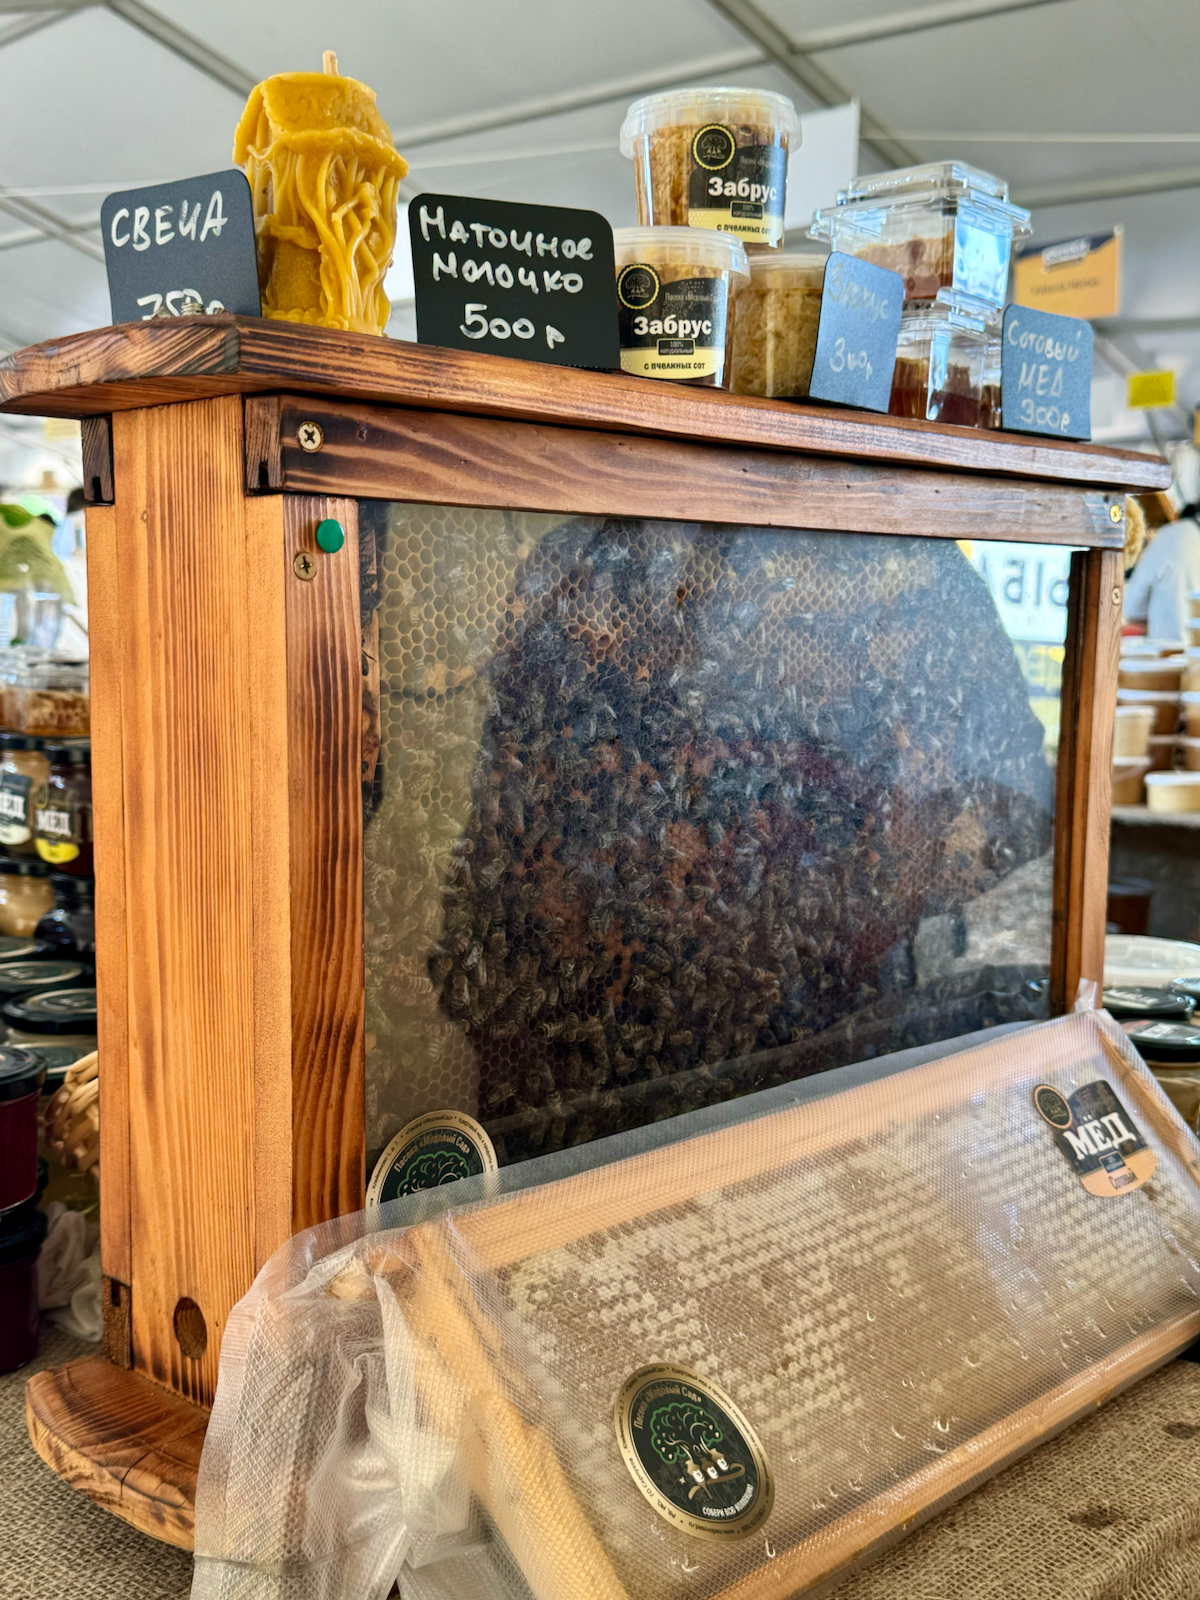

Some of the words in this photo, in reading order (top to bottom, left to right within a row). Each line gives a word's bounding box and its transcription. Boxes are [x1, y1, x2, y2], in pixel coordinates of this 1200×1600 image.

[708, 176, 777, 203] Забрус
[111, 190, 228, 251] СВЕЧА
[724, 224, 760, 233] пчелиных
[459, 303, 536, 340] 500
[633, 314, 712, 339] Забрус
[1062, 1112, 1137, 1161] МЁД
[393, 1145, 419, 1172] Пасека
